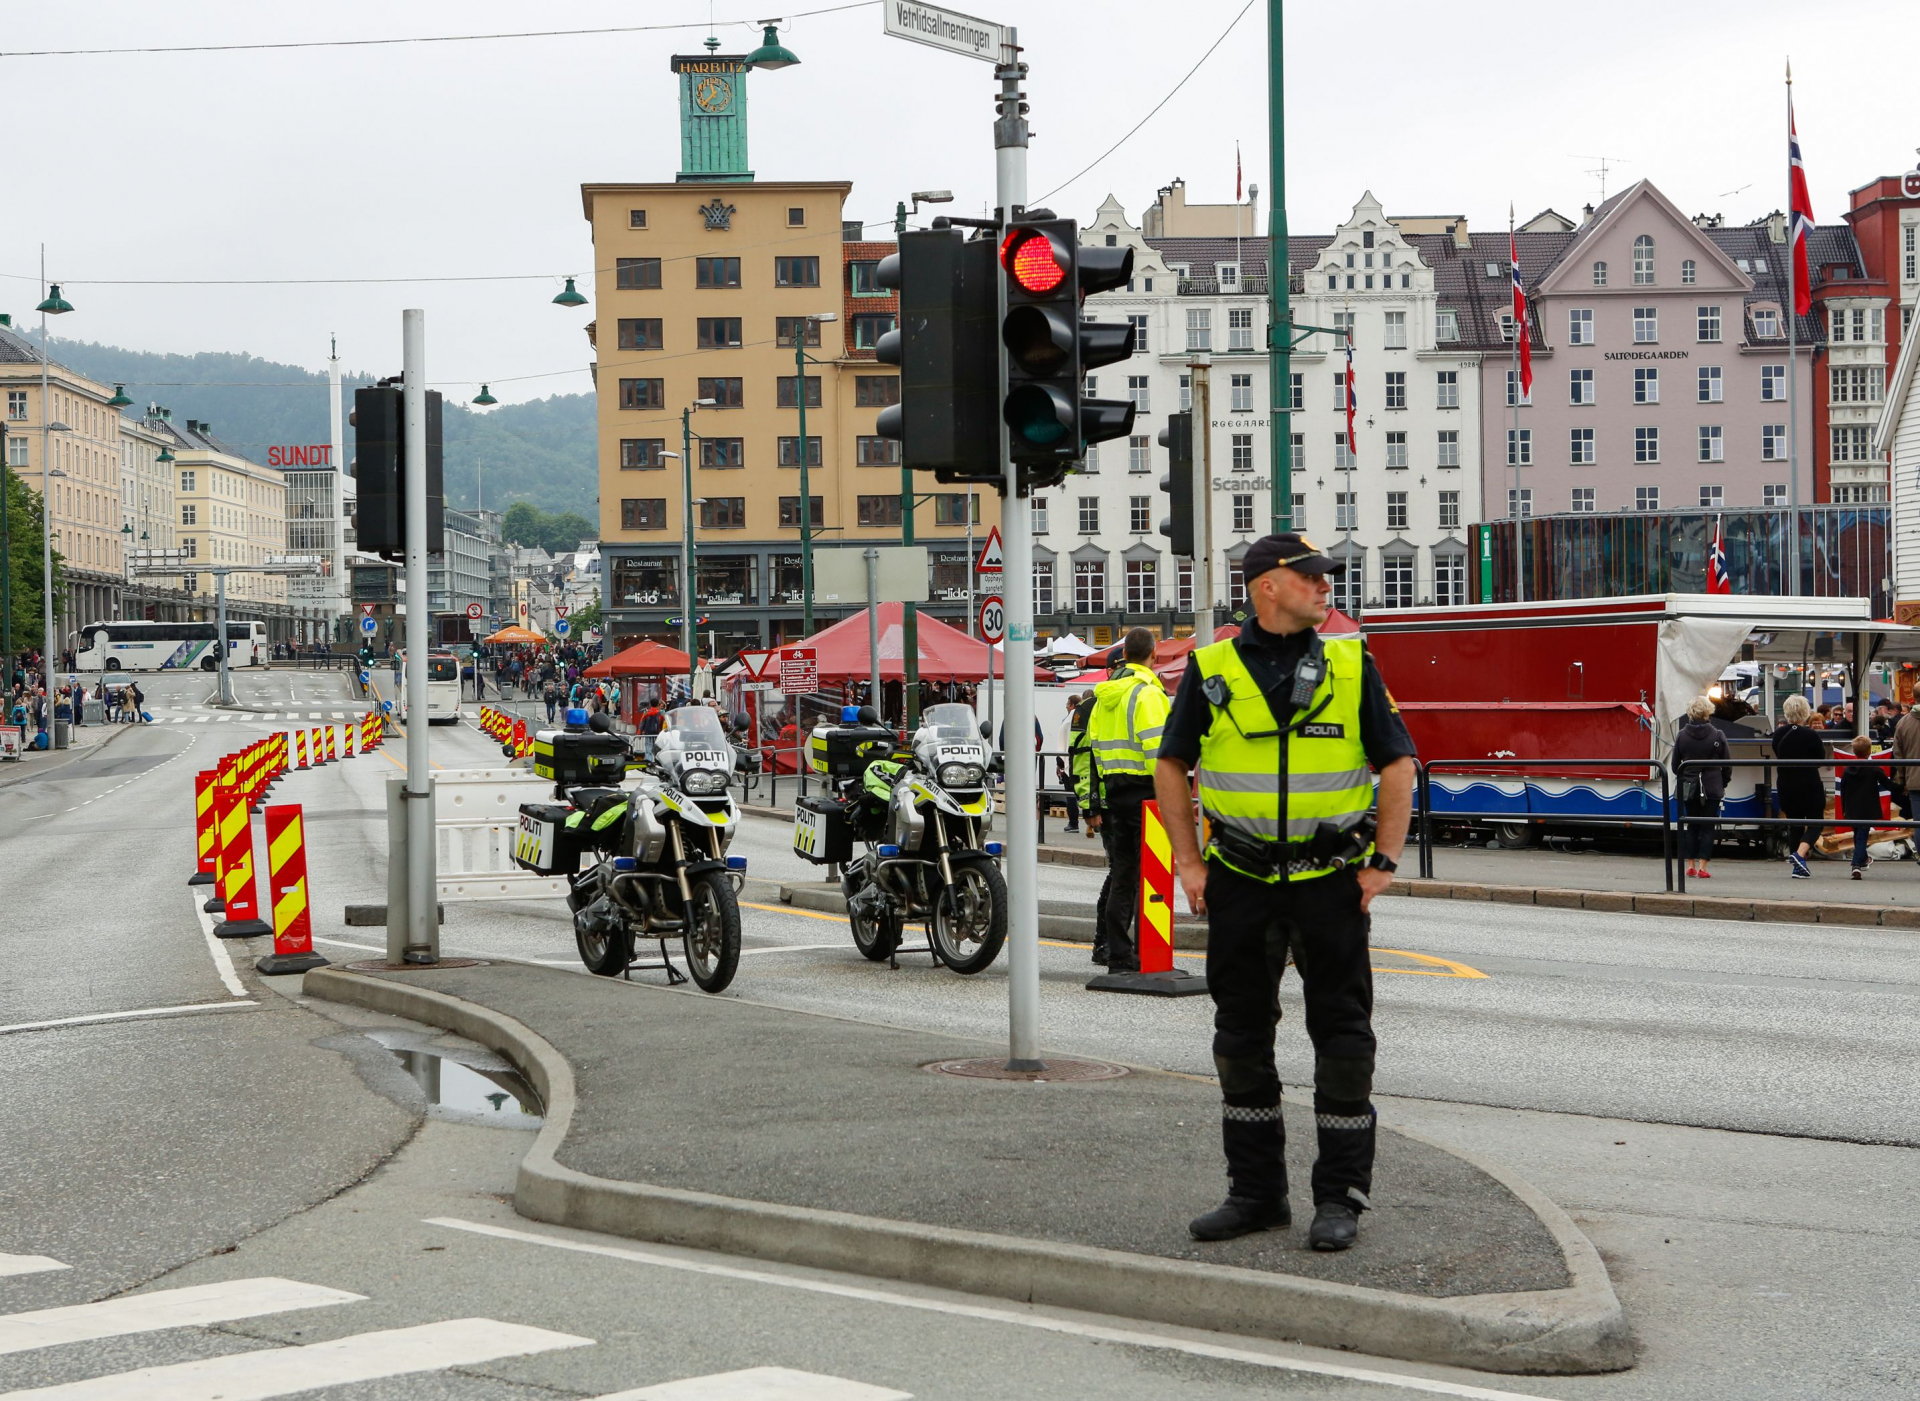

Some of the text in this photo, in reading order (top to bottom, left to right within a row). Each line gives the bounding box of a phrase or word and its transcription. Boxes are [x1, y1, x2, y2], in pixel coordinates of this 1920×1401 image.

[896, 2, 990, 52] Vetrlidsallmenningen
[680, 62, 745, 73] HARBITZ
[1604, 351, 1689, 361] SALTØDEGAARDEN
[1211, 419, 1271, 428] RGEGAARD
[268, 445, 333, 466] SUNDT
[1212, 476, 1272, 491] Scandic
[635, 592, 659, 604] lido
[947, 587, 969, 598] lido
[985, 608, 1003, 632] 30
[1305, 725, 1339, 736] POLITI
[685, 751, 726, 763] POLITI
[941, 746, 981, 756] POLITI
[538, 765, 549, 778] 710
[923, 779, 941, 796] POLITI
[663, 787, 684, 805] POLITI
[796, 807, 817, 828] POLITI
[519, 814, 543, 837] POLITI
